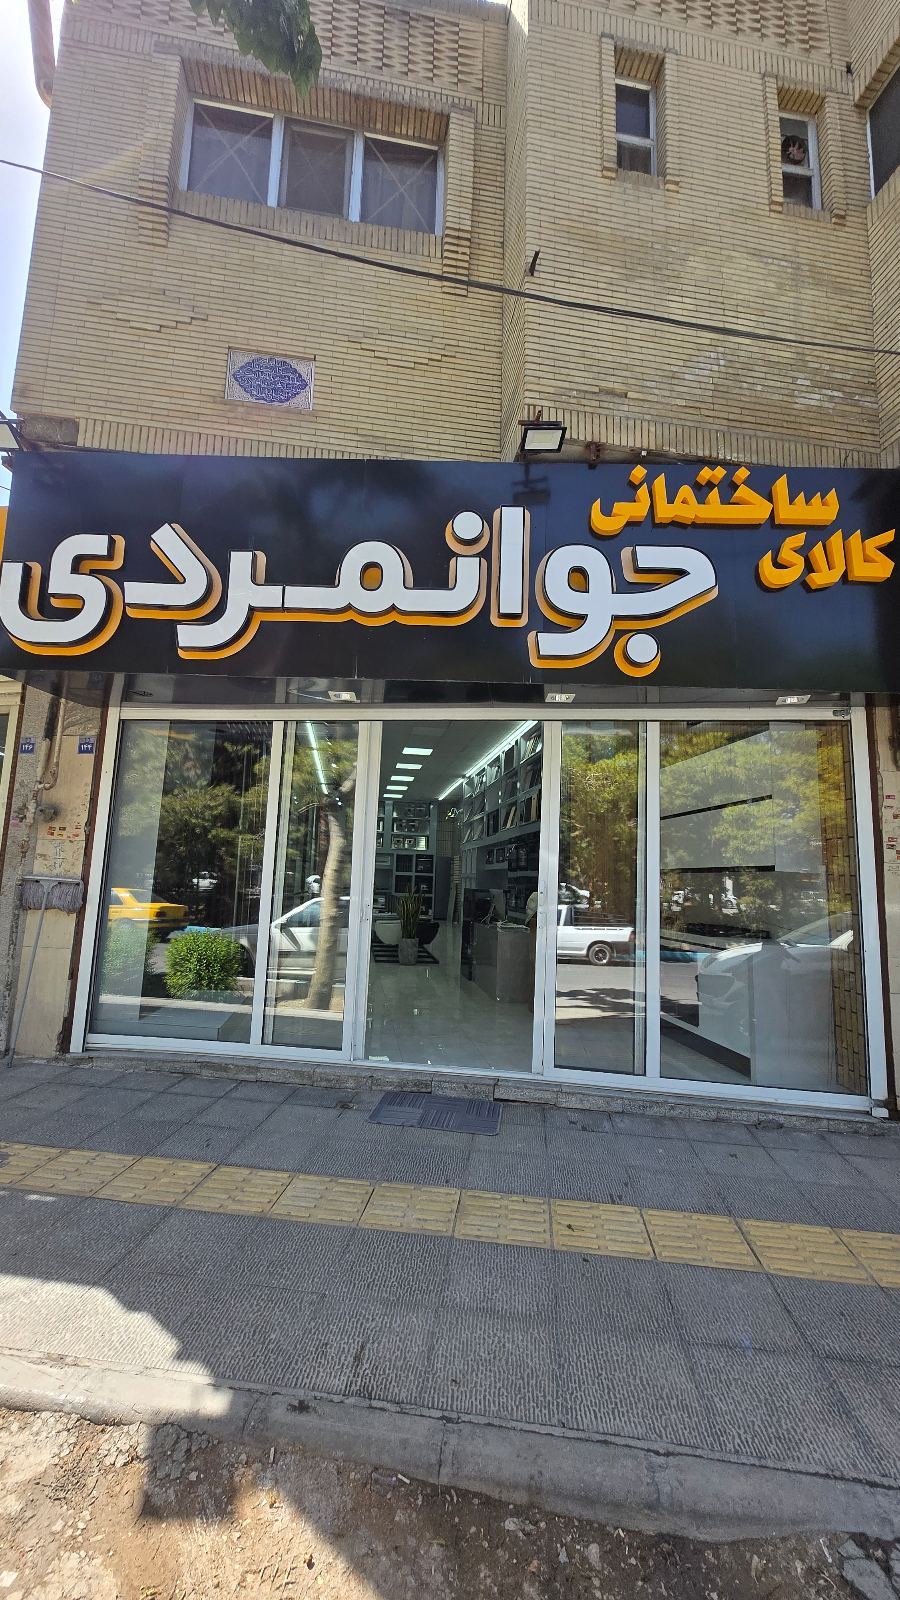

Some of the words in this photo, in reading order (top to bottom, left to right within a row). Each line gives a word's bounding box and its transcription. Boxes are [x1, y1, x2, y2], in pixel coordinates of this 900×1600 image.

[590, 465, 839, 536] ساختمانی
[0, 506, 719, 677] جوانمردی
[758, 528, 895, 589] کالای
